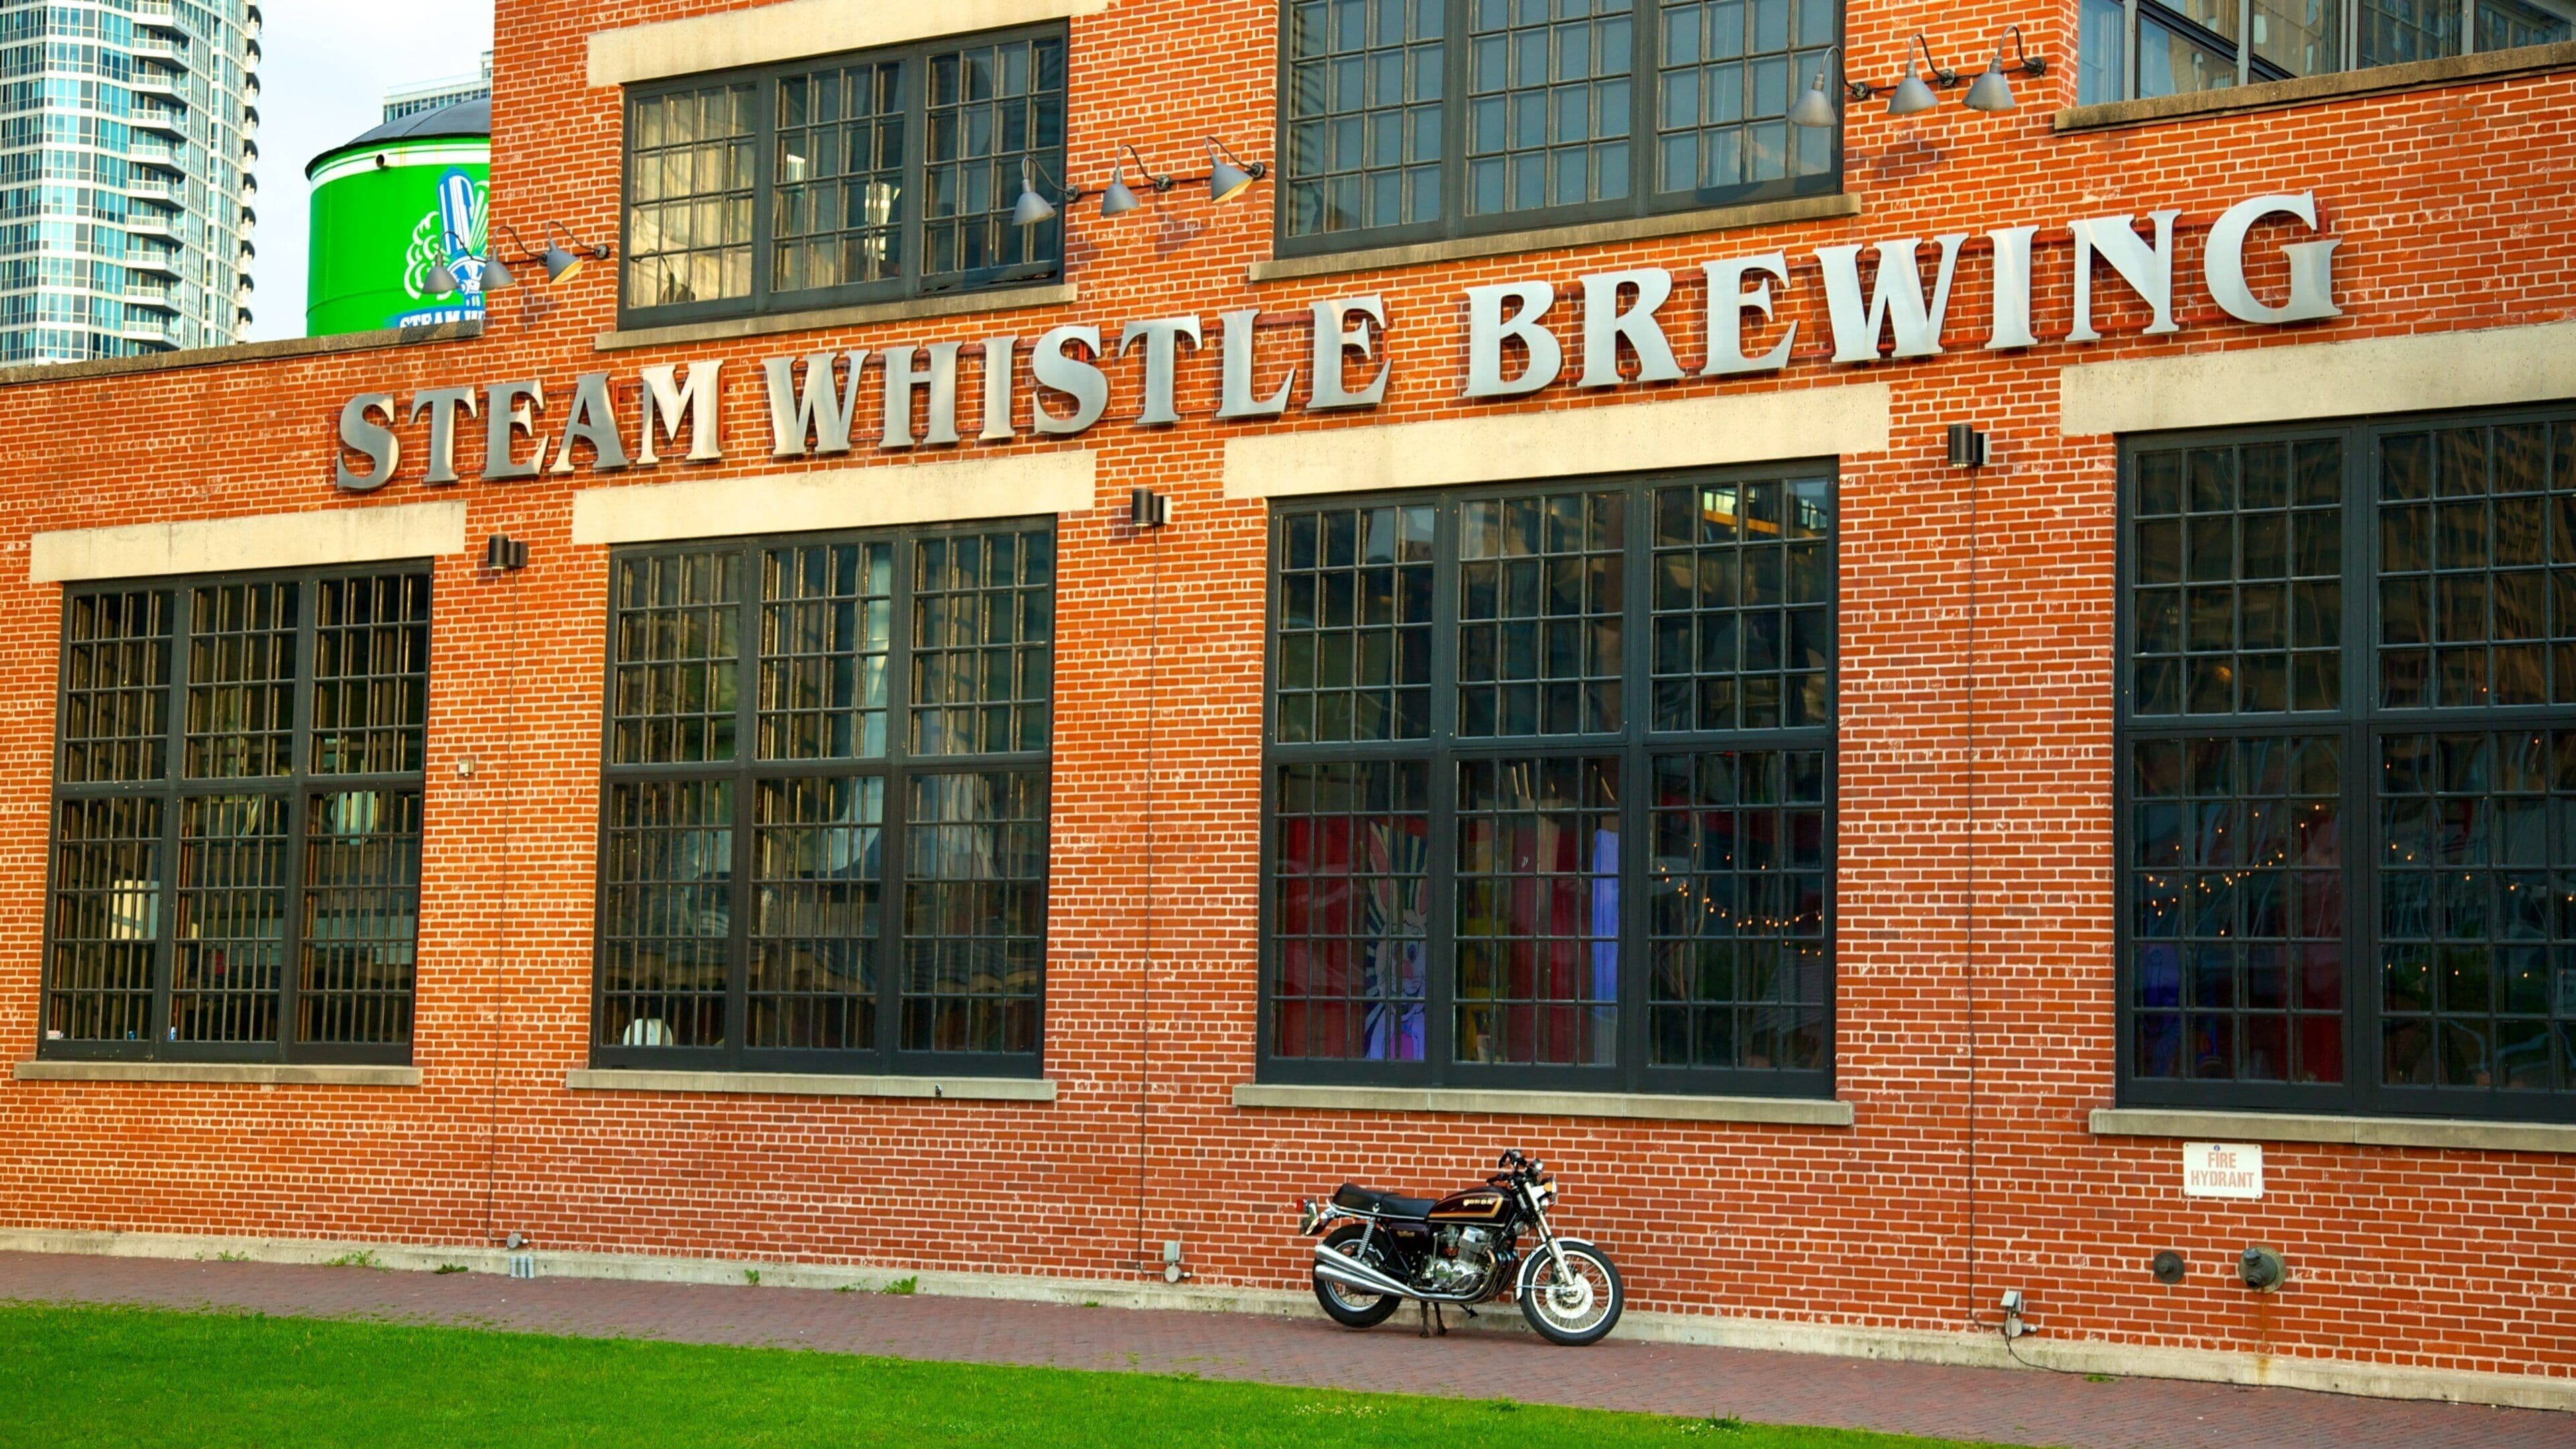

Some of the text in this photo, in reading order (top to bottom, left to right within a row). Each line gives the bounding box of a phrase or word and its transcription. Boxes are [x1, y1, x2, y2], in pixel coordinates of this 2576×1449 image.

[400, 311, 461, 328] STEAM
[337, 190, 2343, 493] STEAM WHISTLE BREWING
[2208, 1152, 2237, 1168] FIRE
[2191, 1170, 2254, 1188] HYDRANT
